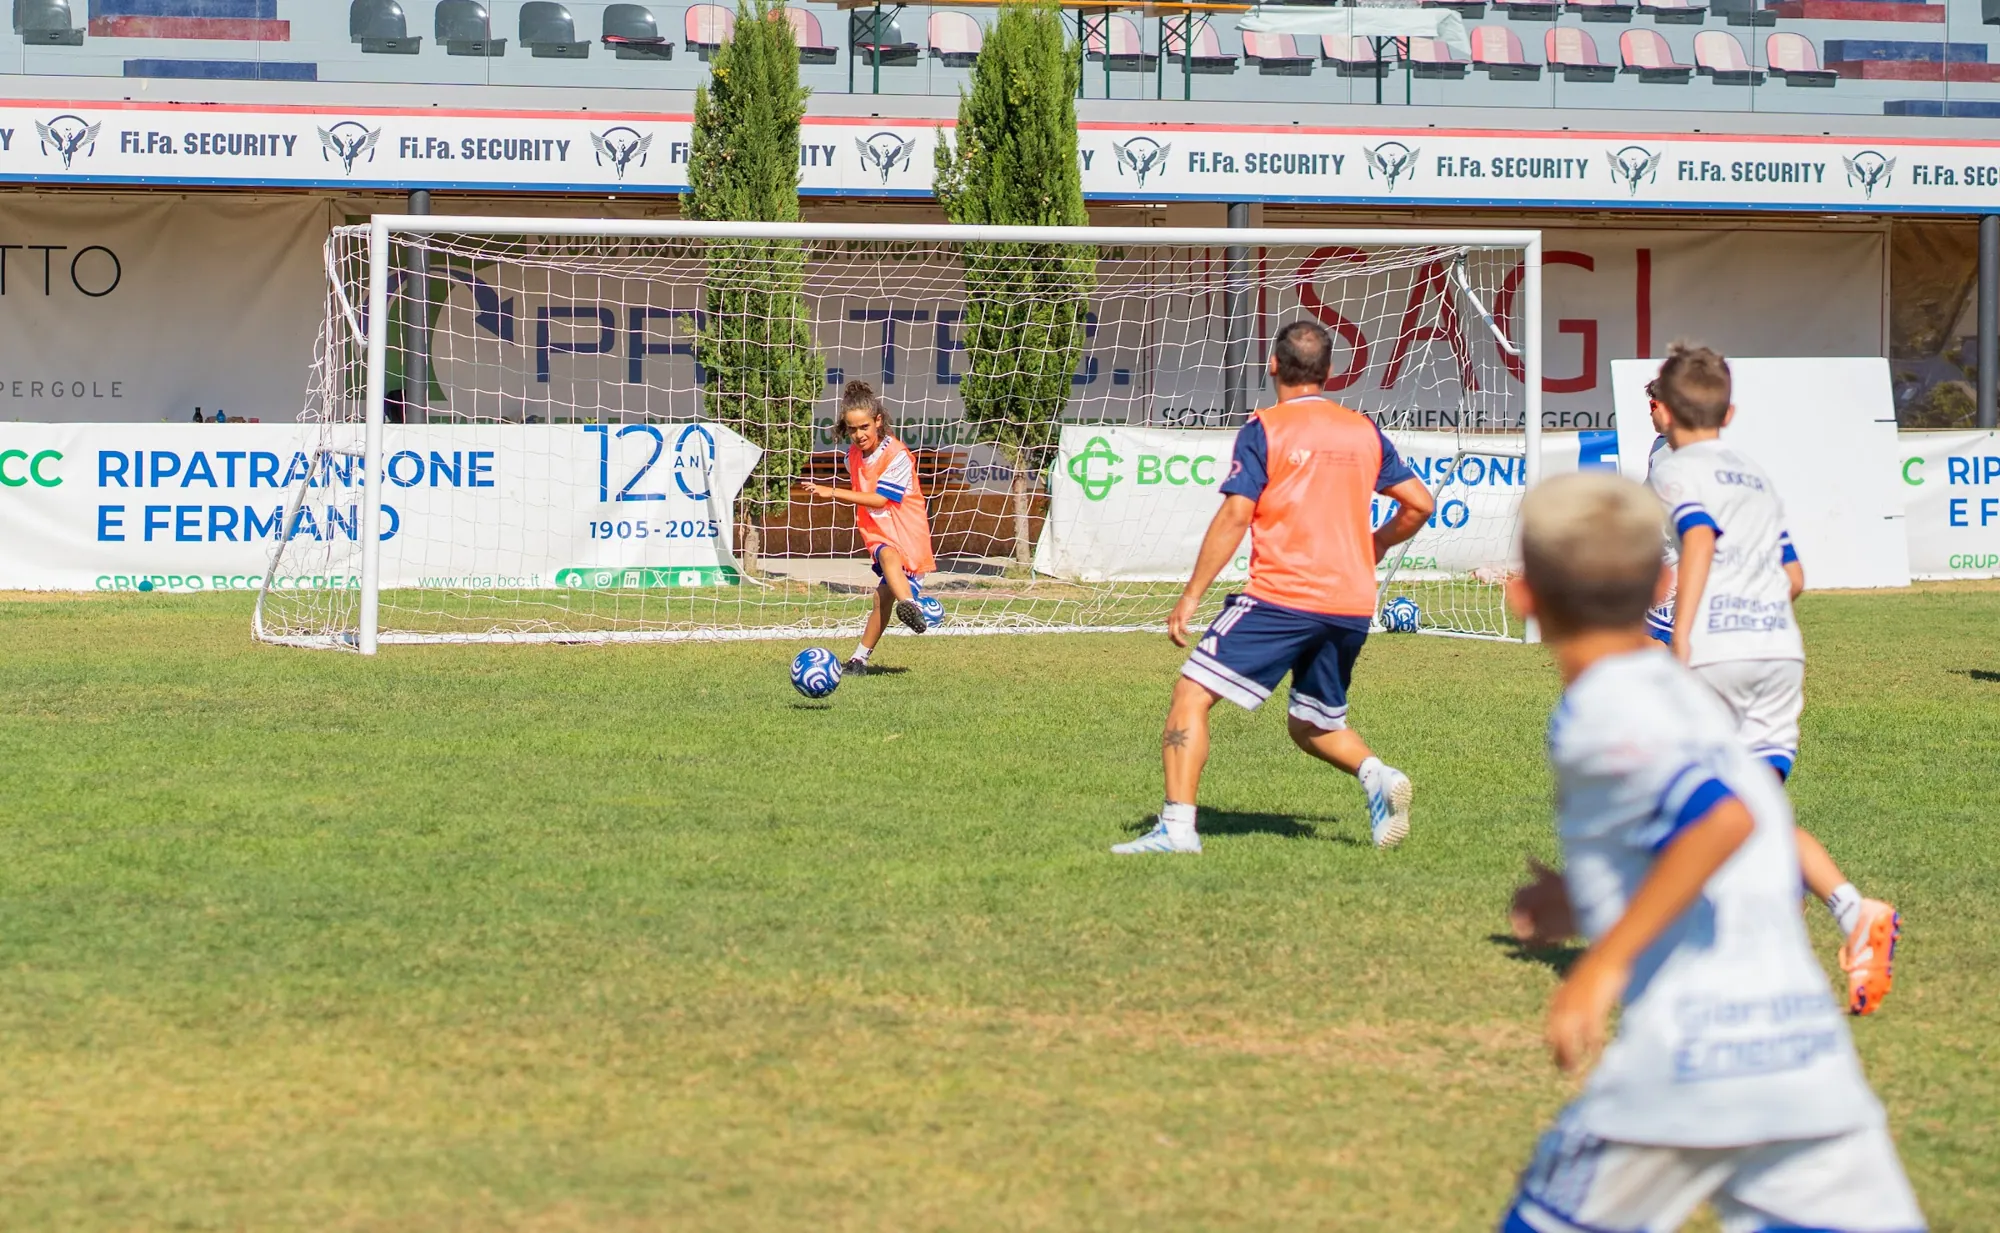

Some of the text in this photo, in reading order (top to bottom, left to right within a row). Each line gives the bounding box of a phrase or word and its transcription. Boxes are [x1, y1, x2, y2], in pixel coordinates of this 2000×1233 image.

[121, 131, 297, 156] Fi.Fa. SECURITY
[400, 136, 570, 162] Fi.Fa. SECURITY
[1188, 151, 1344, 175] Fi.Fa. SECURITY
[1437, 156, 1588, 179] Fi.Fa. SECURITY
[1678, 160, 1826, 183] Fi.Fa. SECURITY
[1913, 165, 2000, 186] Fi.Fa. SEC
[1137, 454, 1216, 486] BCC
[97, 505, 126, 541] E
[1950, 498, 1968, 526] E
